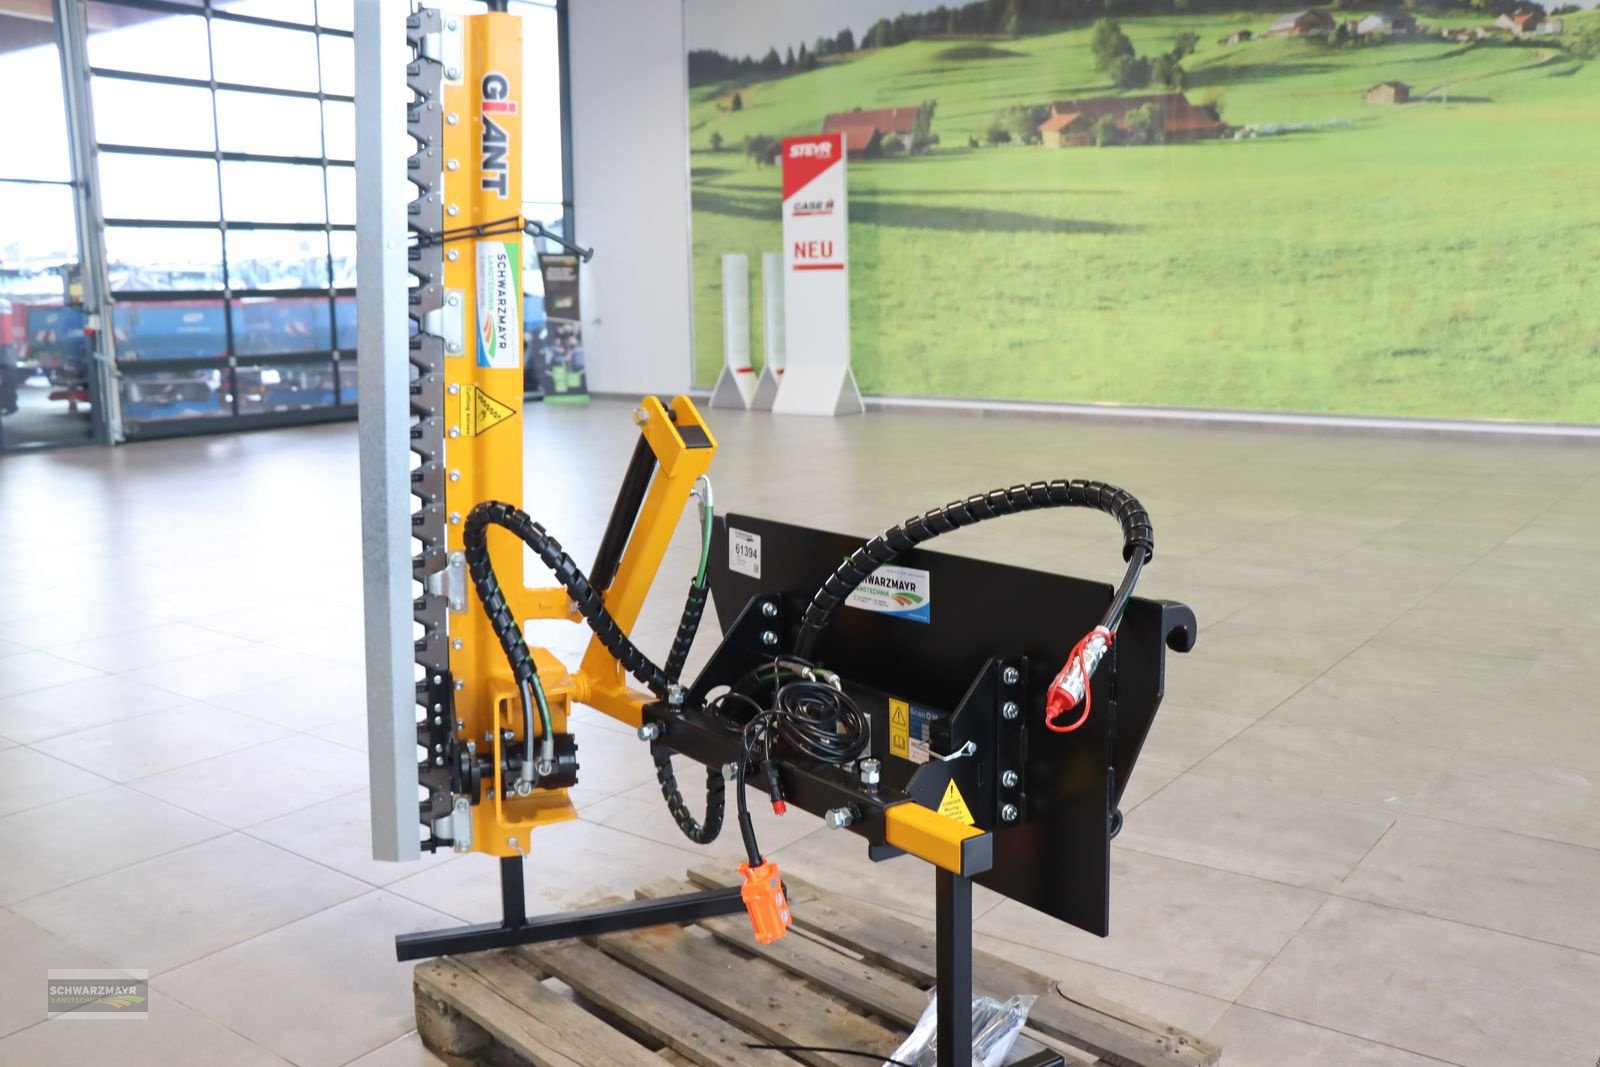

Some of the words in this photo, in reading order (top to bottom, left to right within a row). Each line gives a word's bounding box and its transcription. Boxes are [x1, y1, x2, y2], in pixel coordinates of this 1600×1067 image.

[789, 141, 832, 158] STEYR
[794, 201, 822, 210] CASE
[794, 241, 833, 259] NEU
[497, 253, 506, 349] SCHWARZMAYR
[735, 543, 758, 560] 61394
